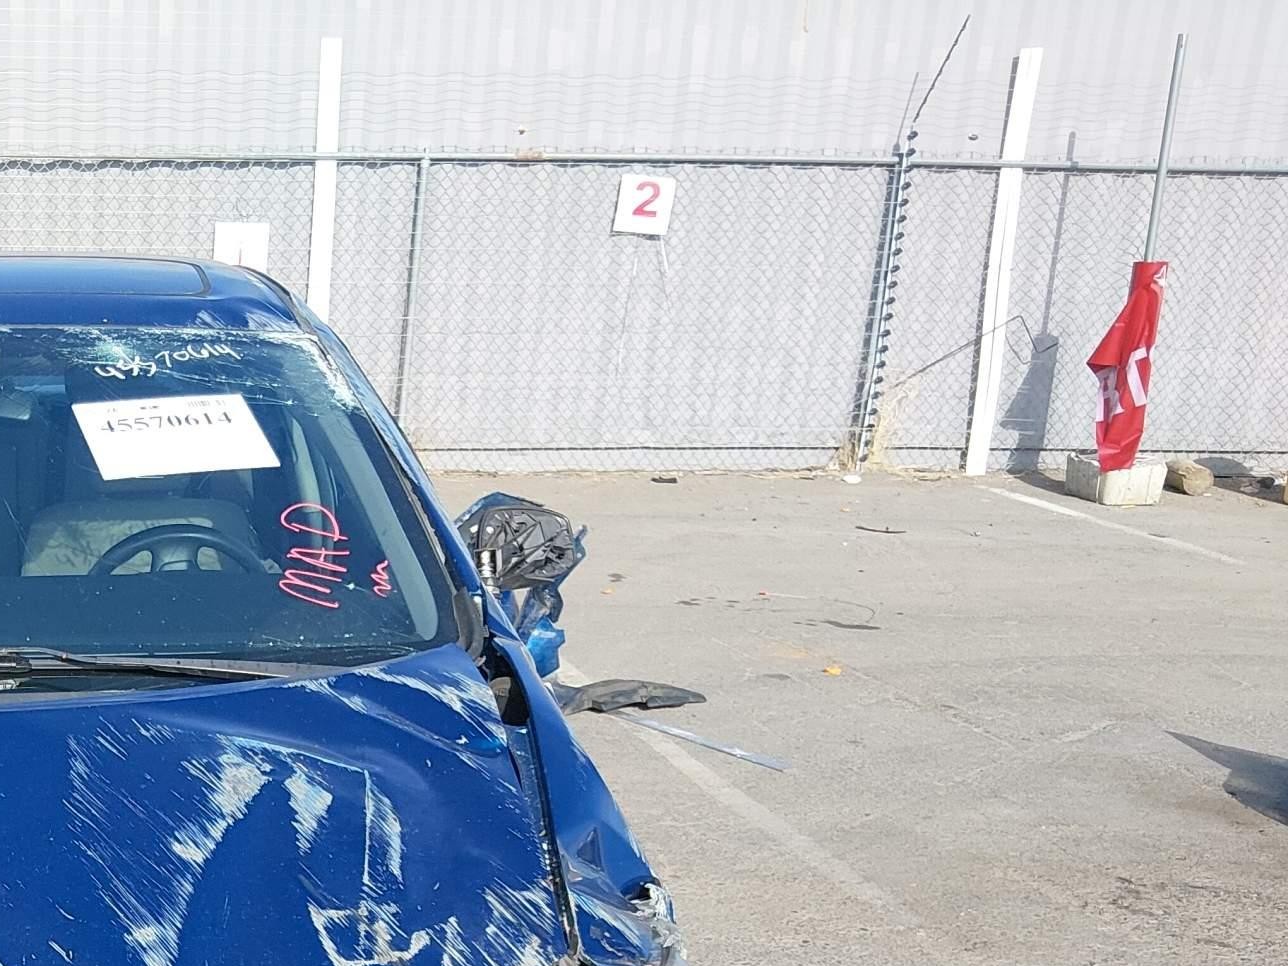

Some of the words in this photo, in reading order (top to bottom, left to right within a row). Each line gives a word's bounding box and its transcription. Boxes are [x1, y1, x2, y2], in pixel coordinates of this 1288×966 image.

[632, 181, 660, 217] 2
[100, 411, 232, 432] 45570614
[279, 503, 350, 608] MAD
